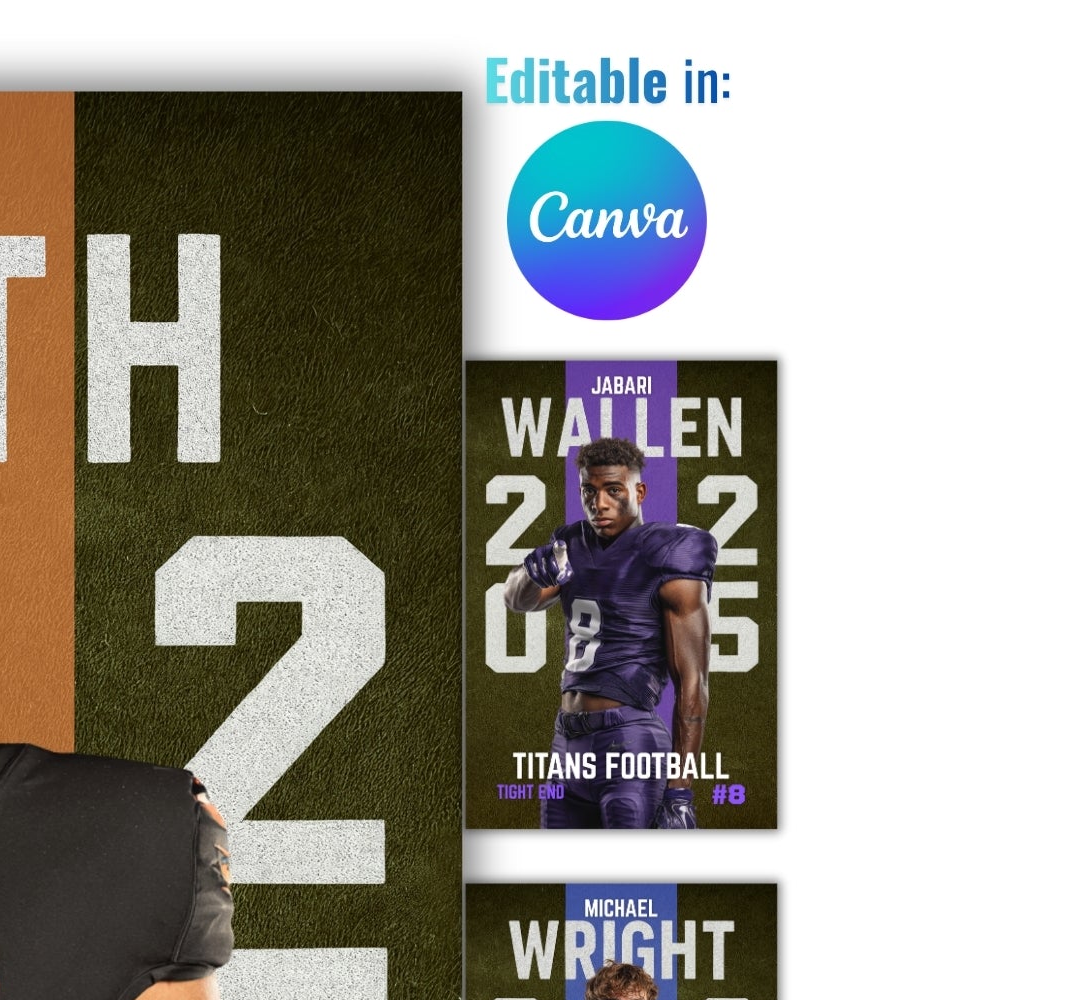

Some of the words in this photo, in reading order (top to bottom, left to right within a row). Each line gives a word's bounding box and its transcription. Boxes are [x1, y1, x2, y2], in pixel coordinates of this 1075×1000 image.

[591, 376, 652, 395] JABARI
[501, 397, 743, 458] WALLEN
[485, 474, 547, 566] 2
[697, 474, 758, 566] 2
[565, 599, 603, 672] 8
[154, 535, 387, 885] 2
[497, 784, 534, 800] TIGHT
[538, 784, 565, 800] END
[513, 752, 596, 780] TITANS
[606, 752, 729, 780] FOOTBALL
[712, 784, 746, 804] #8
[584, 898, 658, 918] MICHAEL
[508, 919, 735, 981] WRIGHT
